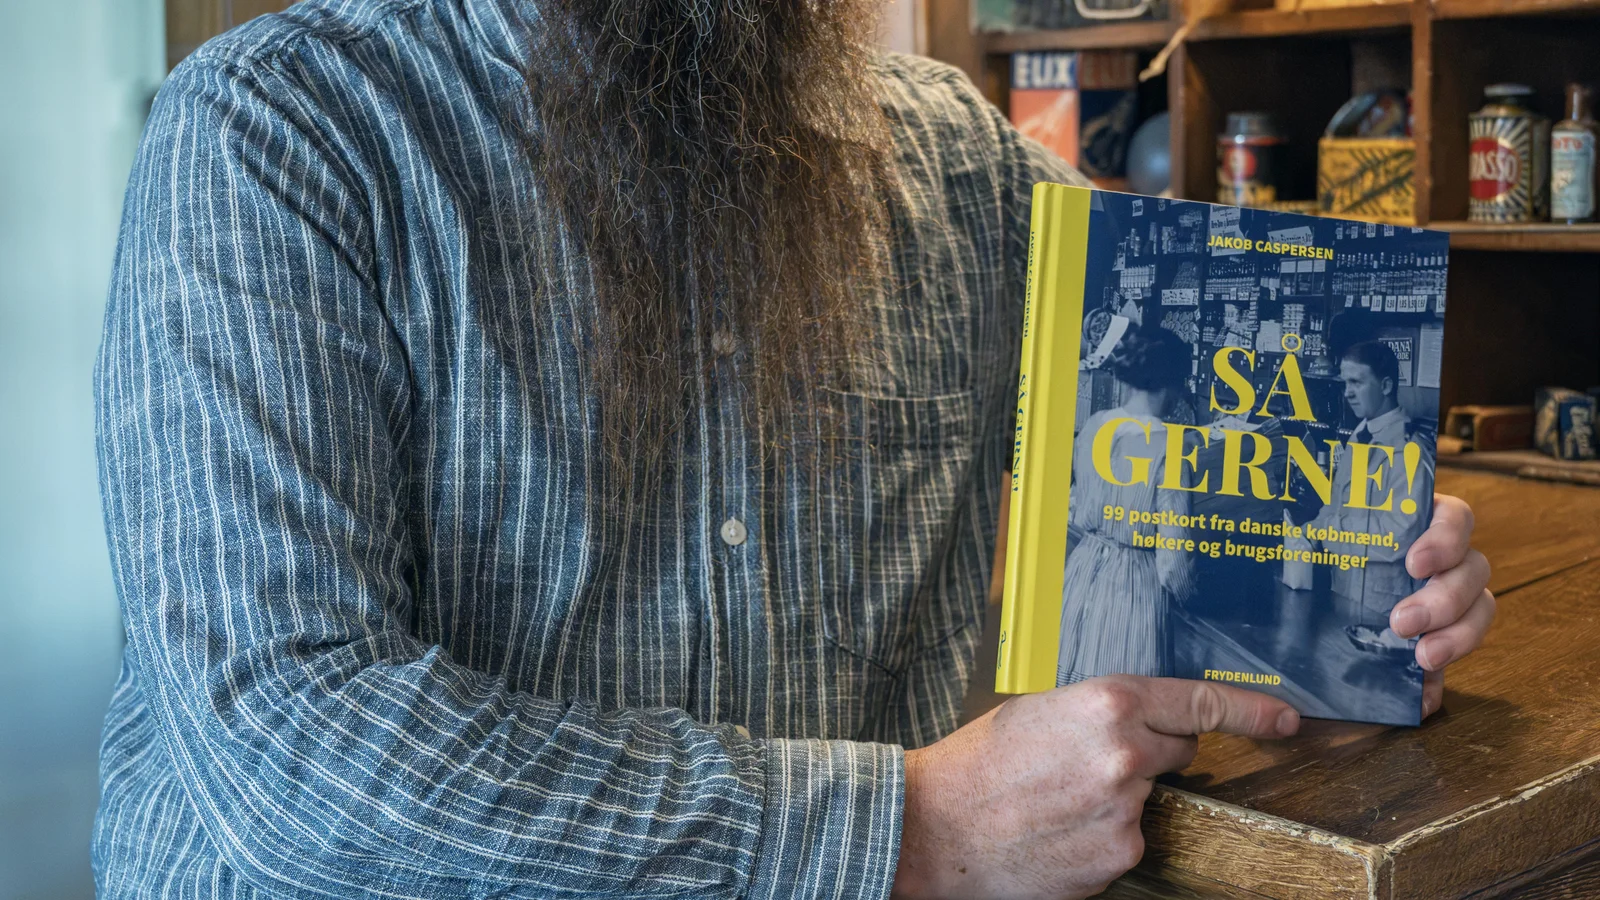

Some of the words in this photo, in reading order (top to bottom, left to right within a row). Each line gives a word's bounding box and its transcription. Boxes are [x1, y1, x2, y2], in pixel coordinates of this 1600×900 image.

[1207, 235, 1253, 251] JAKOB
[1255, 240, 1334, 261] CASPERSEN
[1210, 333, 1317, 422] SÅ
[1091, 417, 1421, 515] GERNE!
[1103, 504, 1126, 522] 99
[1128, 507, 1207, 530] postkort
[1209, 513, 1236, 533] fra
[1239, 514, 1303, 539] danske
[1306, 523, 1401, 552] købmænd,
[1132, 530, 1196, 552] høkere
[1198, 540, 1222, 559] og
[1224, 538, 1370, 571] brugsforeninger
[1203, 669, 1281, 686] FRYDENLUND
